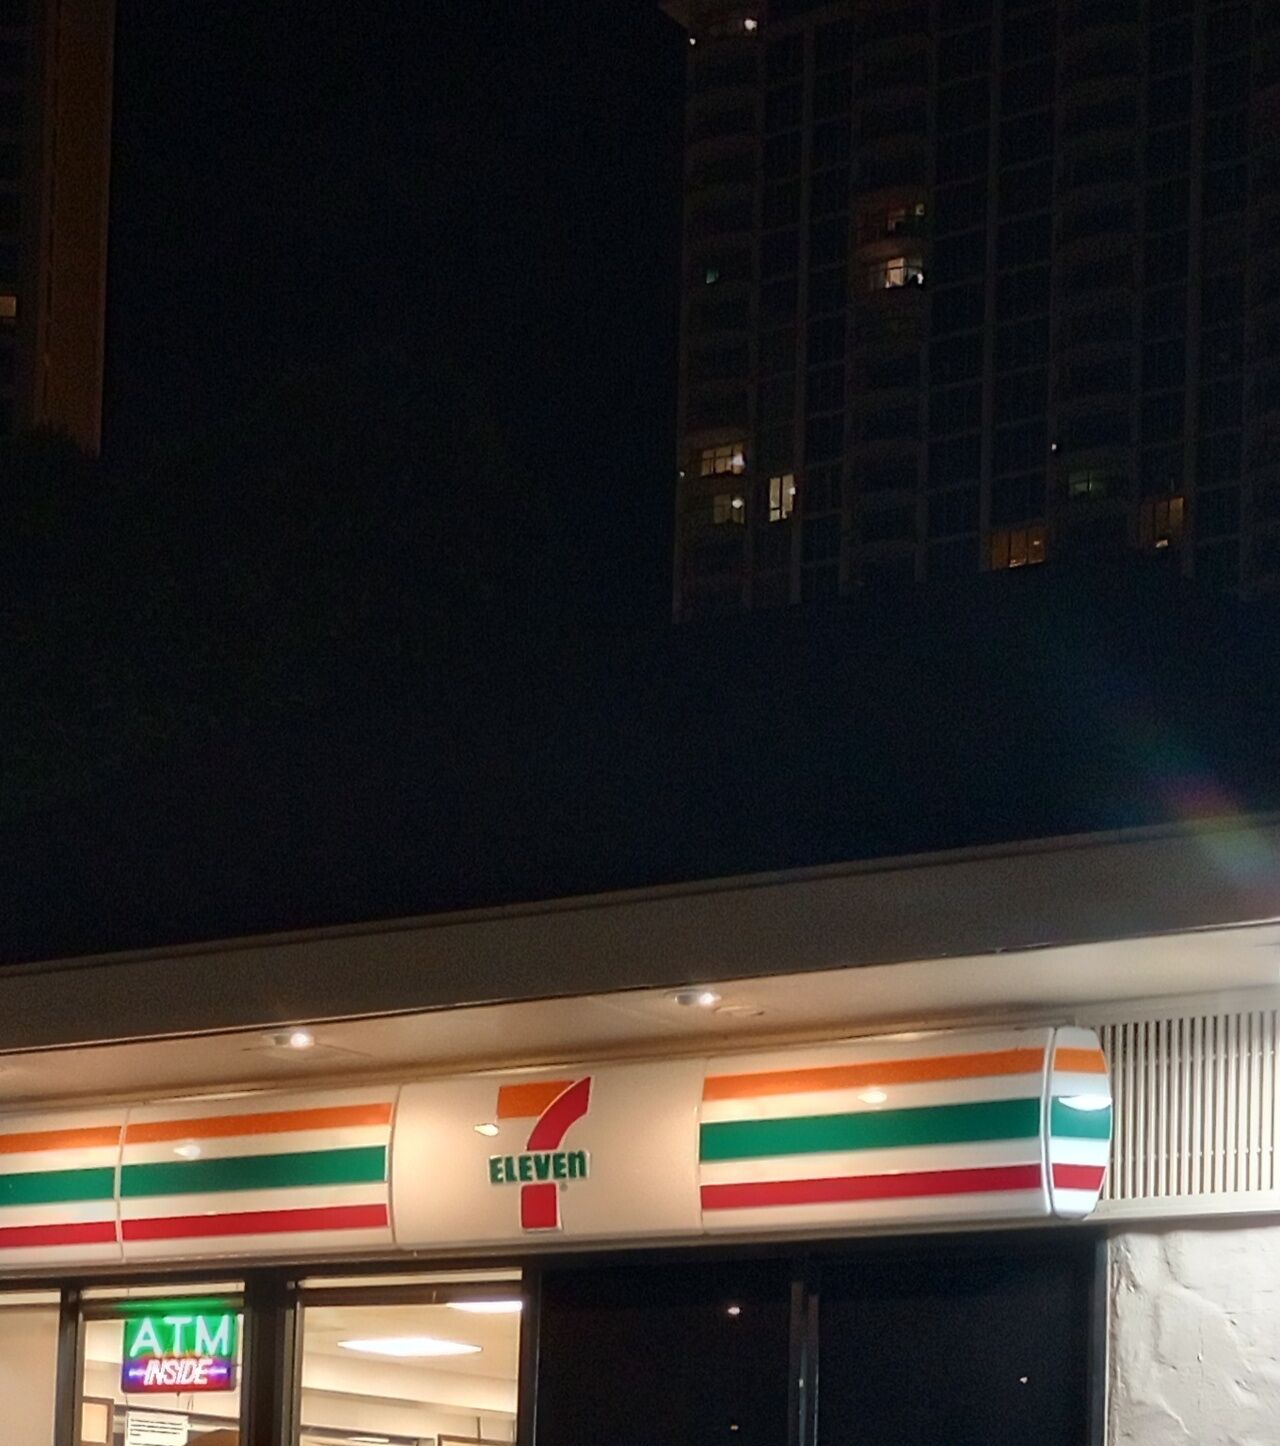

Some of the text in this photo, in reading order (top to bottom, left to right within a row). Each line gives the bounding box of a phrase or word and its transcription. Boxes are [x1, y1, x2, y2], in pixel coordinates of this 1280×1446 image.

[496, 1076, 591, 1229] 7
[129, 1315, 230, 1358] ATM
[143, 1358, 214, 1386] INSIDE
